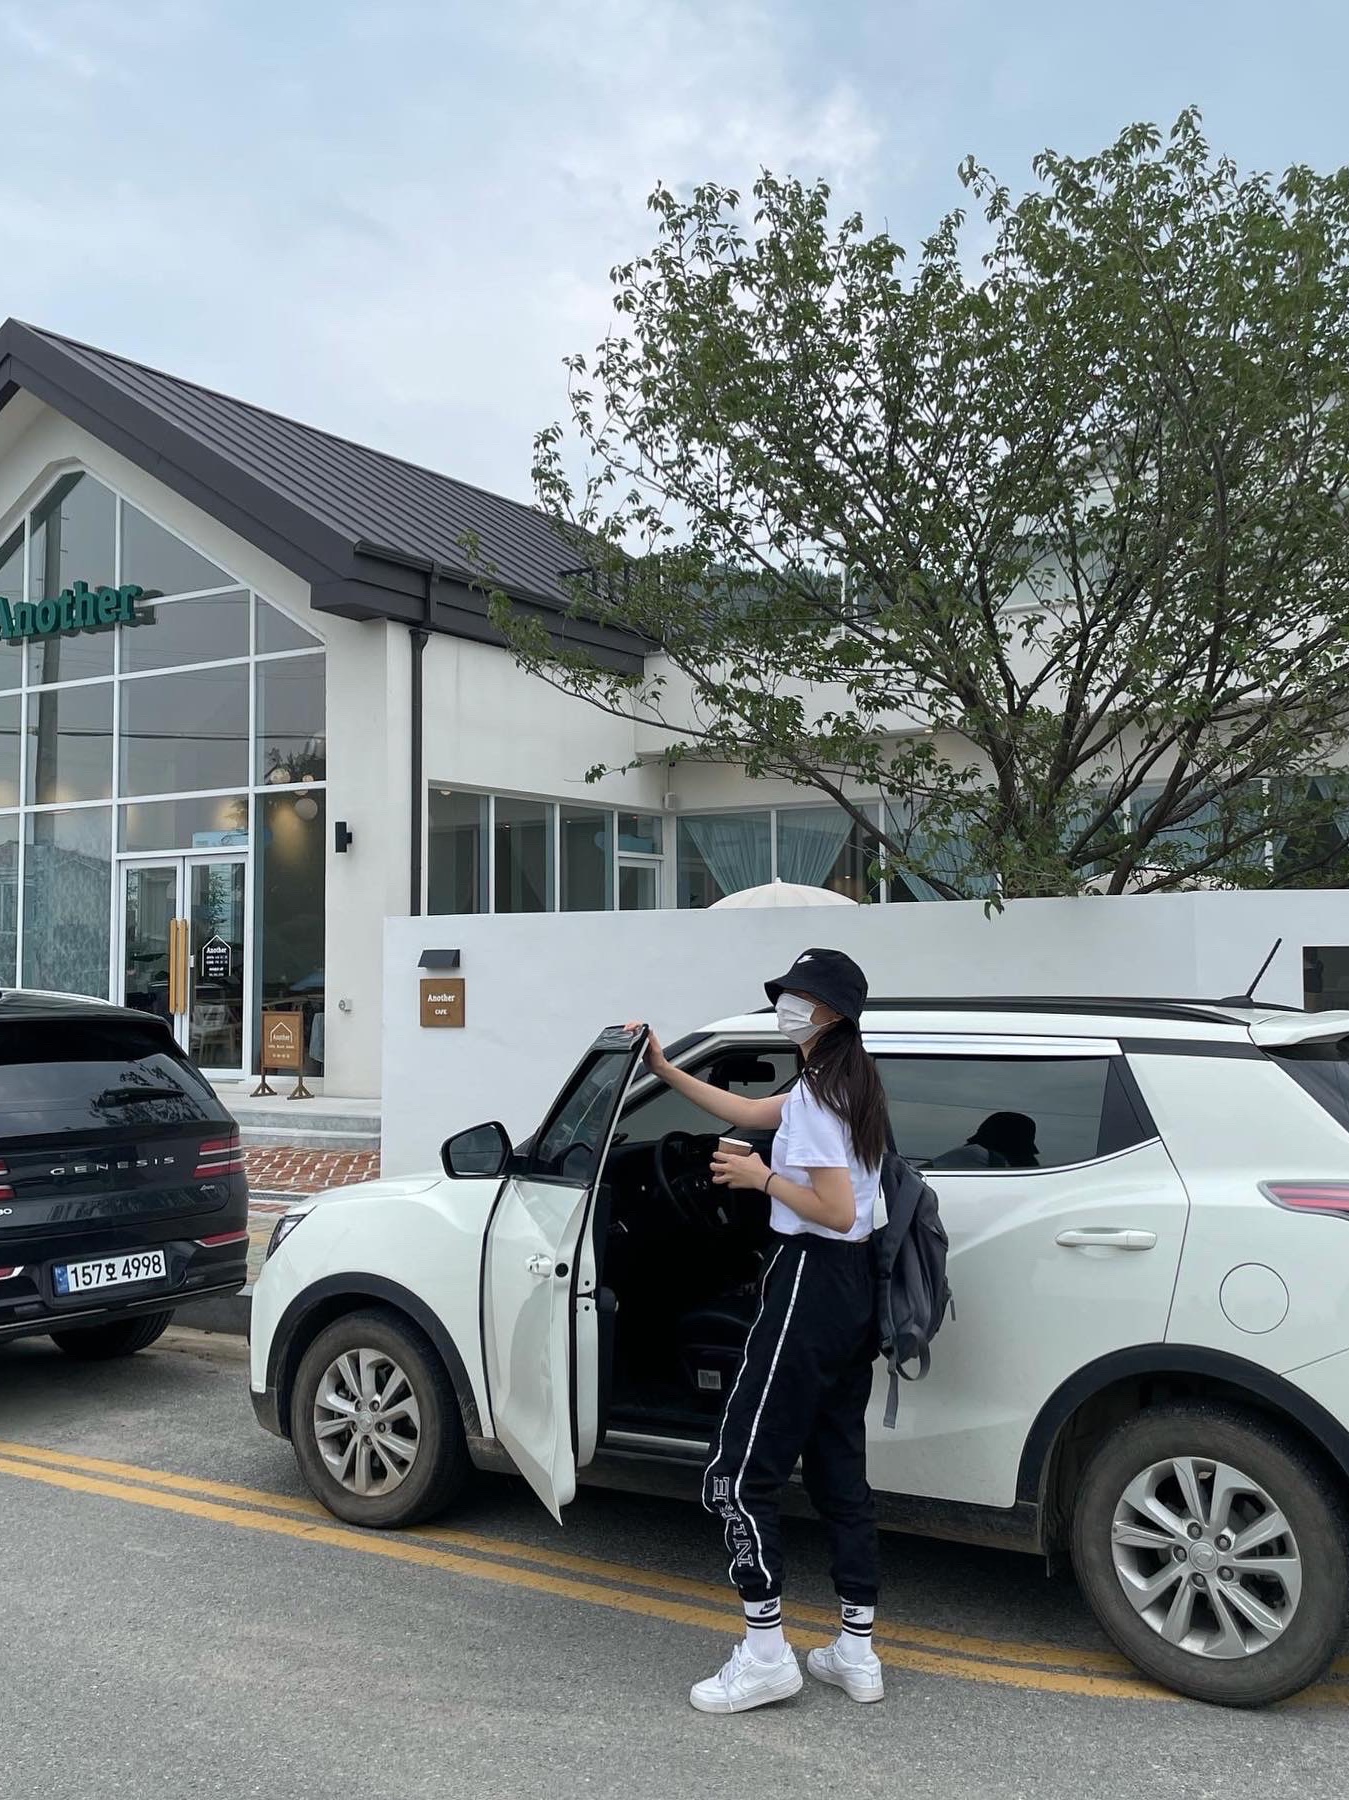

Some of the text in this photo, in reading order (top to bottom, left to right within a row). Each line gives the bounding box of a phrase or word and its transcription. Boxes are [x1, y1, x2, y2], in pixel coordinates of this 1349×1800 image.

[427, 993, 456, 1003] Another
[50, 1156, 175, 1176] GENESIS
[121, 1254, 163, 1279] 4998
